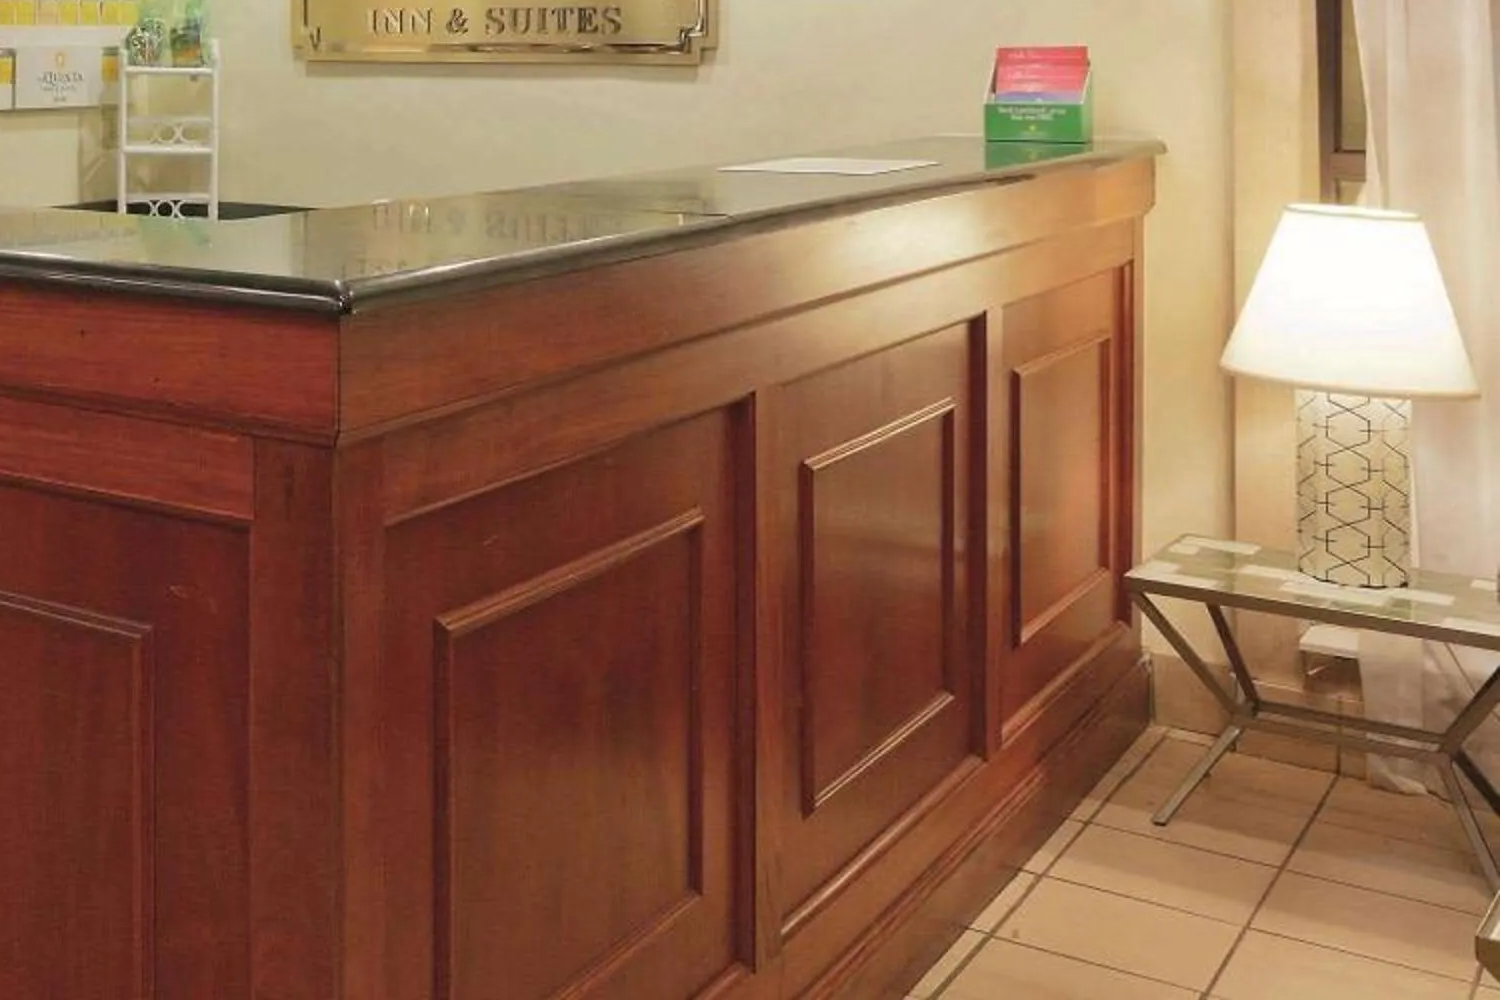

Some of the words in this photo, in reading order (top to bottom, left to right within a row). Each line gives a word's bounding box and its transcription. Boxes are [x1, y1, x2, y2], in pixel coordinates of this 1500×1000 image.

[368, 7, 434, 36] INN
[446, 9, 469, 35] &
[485, 6, 622, 36] SUITES
